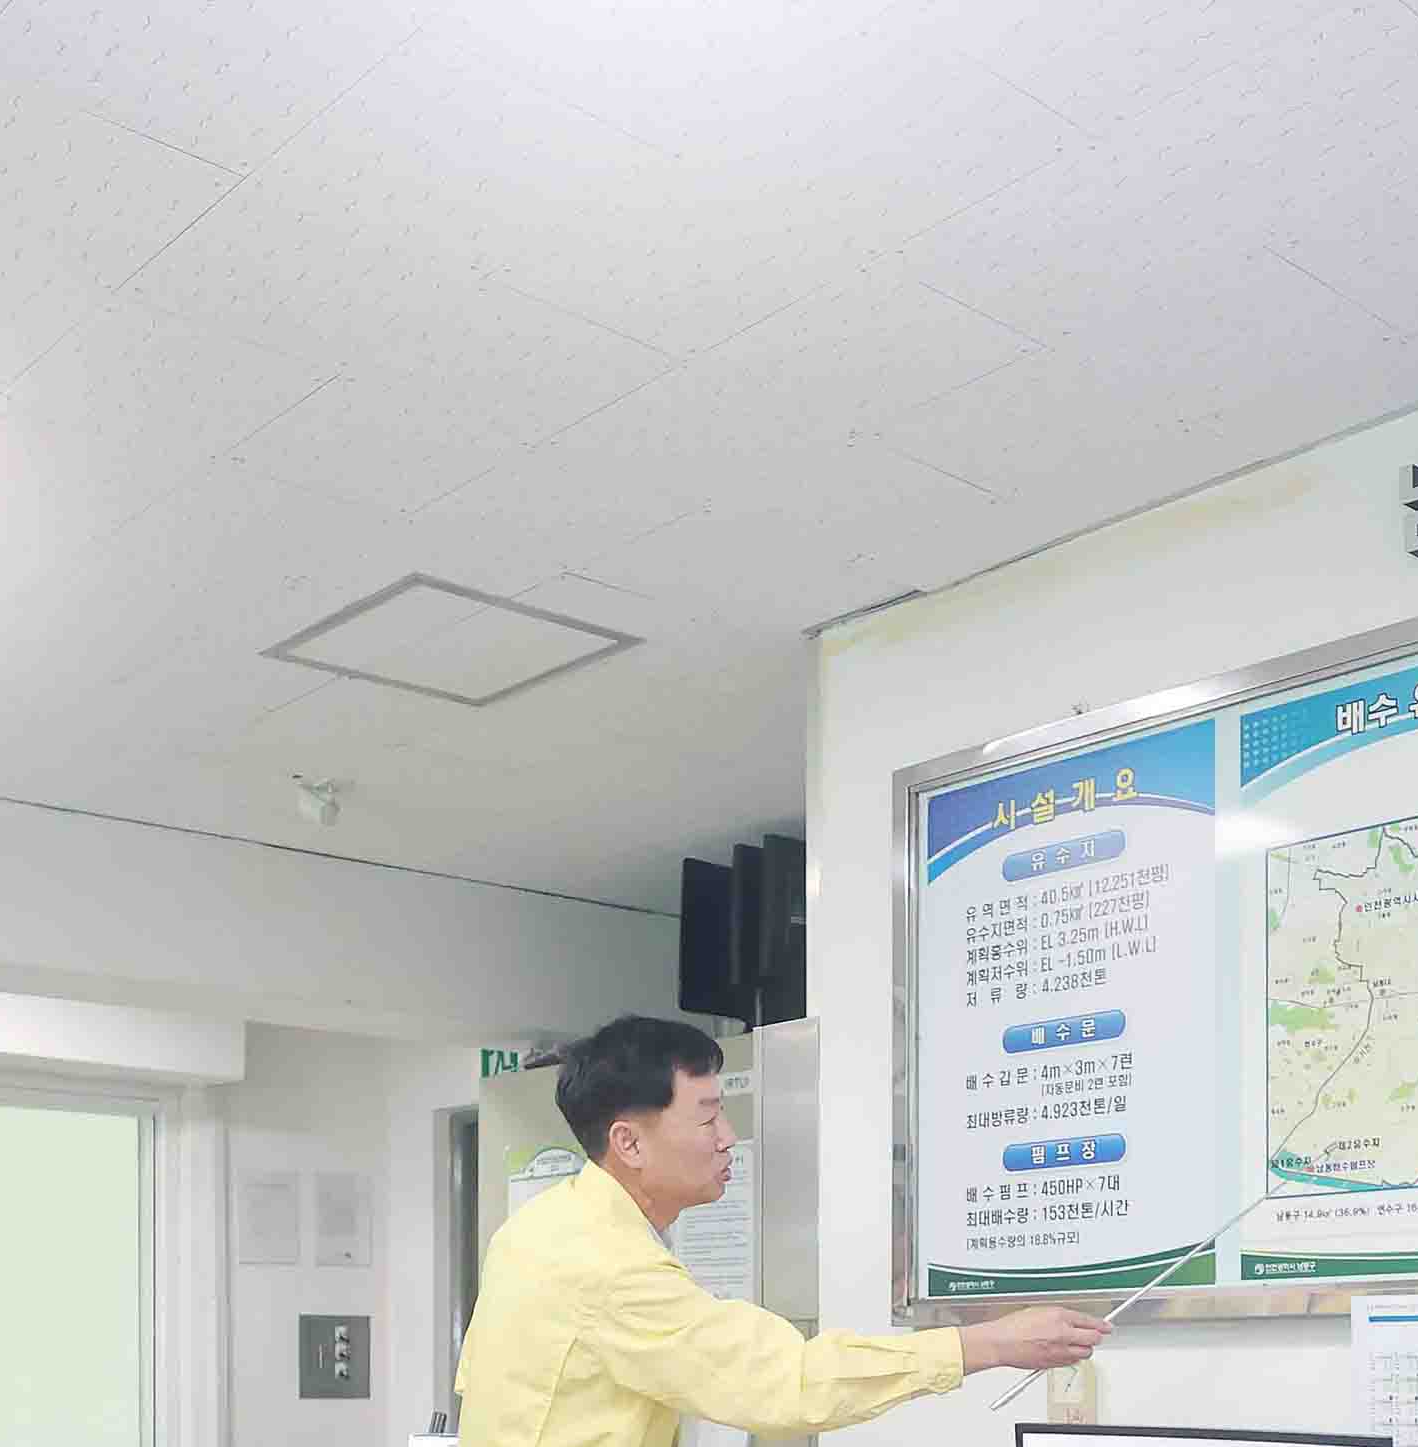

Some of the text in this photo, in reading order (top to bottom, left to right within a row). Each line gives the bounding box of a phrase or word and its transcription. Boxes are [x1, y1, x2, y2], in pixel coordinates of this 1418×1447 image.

[1335, 692, 1400, 736] 배수
[966, 916, 1029, 945] 유수지면적
[1040, 935, 1054, 951] EL
[1057, 925, 1100, 948] 3.25m
[966, 959, 1029, 988] 계획저수위
[1040, 955, 1054, 973] EL
[1057, 946, 1107, 970] -1.50m
[966, 1106, 1029, 1130] 최대방류량
[1040, 1174, 1121, 1197] 450HP×7대
[966, 1199, 1129, 1228] 최대배수량 153천톤/시간
